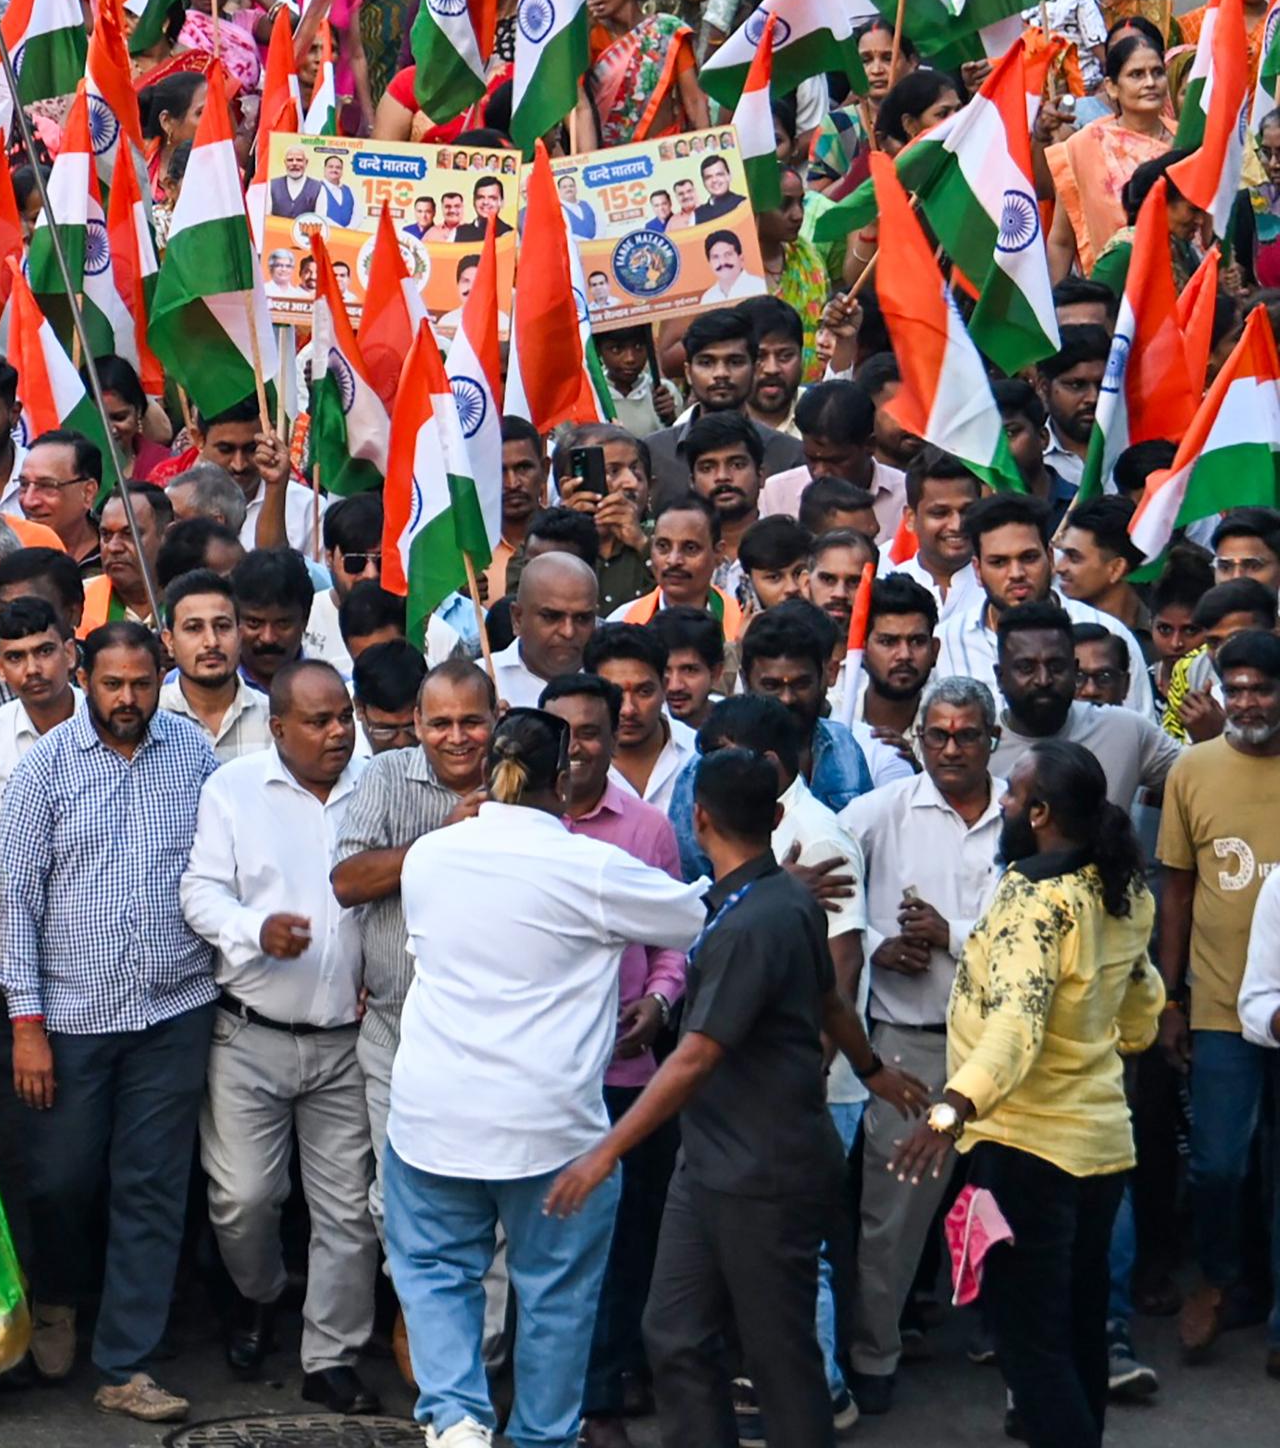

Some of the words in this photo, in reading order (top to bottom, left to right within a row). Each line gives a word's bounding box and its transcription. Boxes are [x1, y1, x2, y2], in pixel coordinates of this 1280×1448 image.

[357, 155, 381, 172] वन्दे
[382, 159, 420, 178] मातरम्
[587, 165, 610, 181] वन्दे
[610, 160, 649, 177] मातरम्
[615, 238, 635, 267] VANDE
[634, 233, 674, 258] MATARAM
